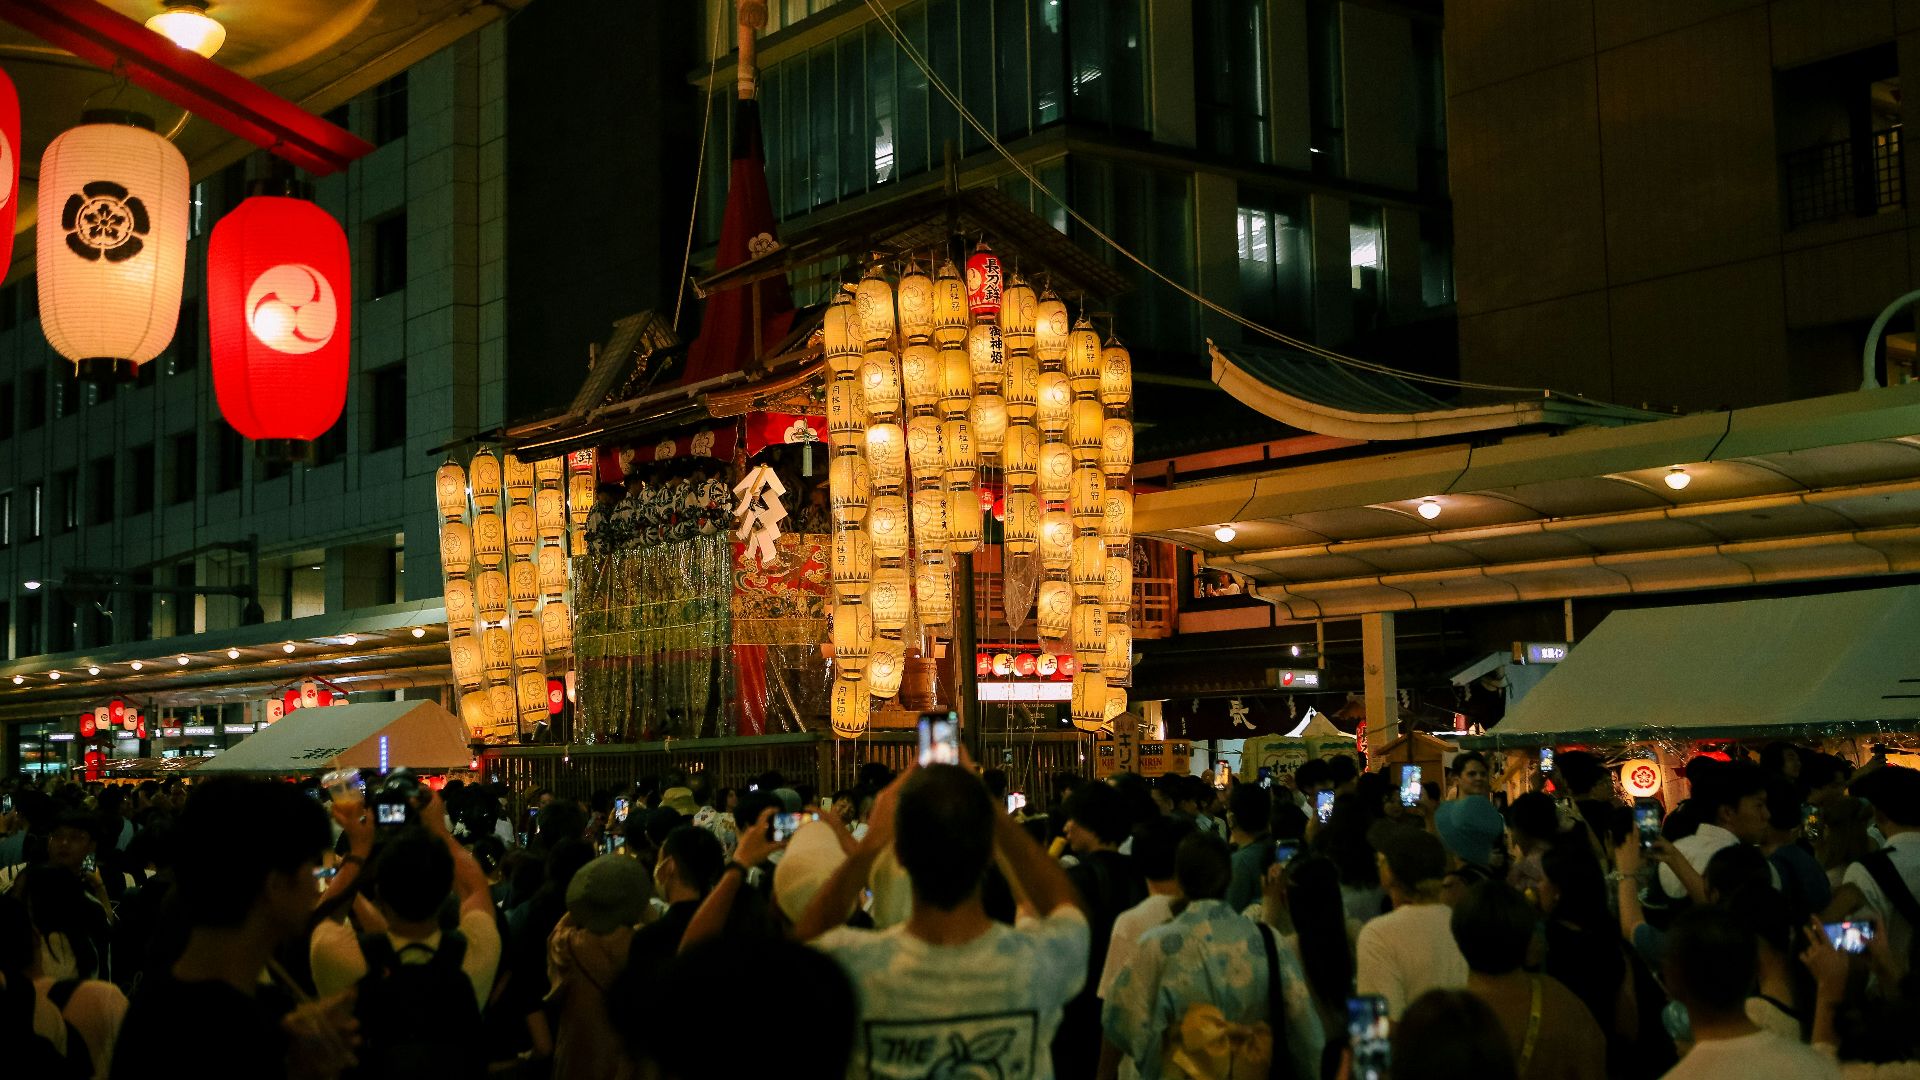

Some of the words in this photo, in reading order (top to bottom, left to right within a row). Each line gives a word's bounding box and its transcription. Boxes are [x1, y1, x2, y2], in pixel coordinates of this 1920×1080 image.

[984, 258, 1001, 304] 長刀鉾
[1139, 757, 1163, 767] KIRIN
[881, 1036, 937, 1064] THE
